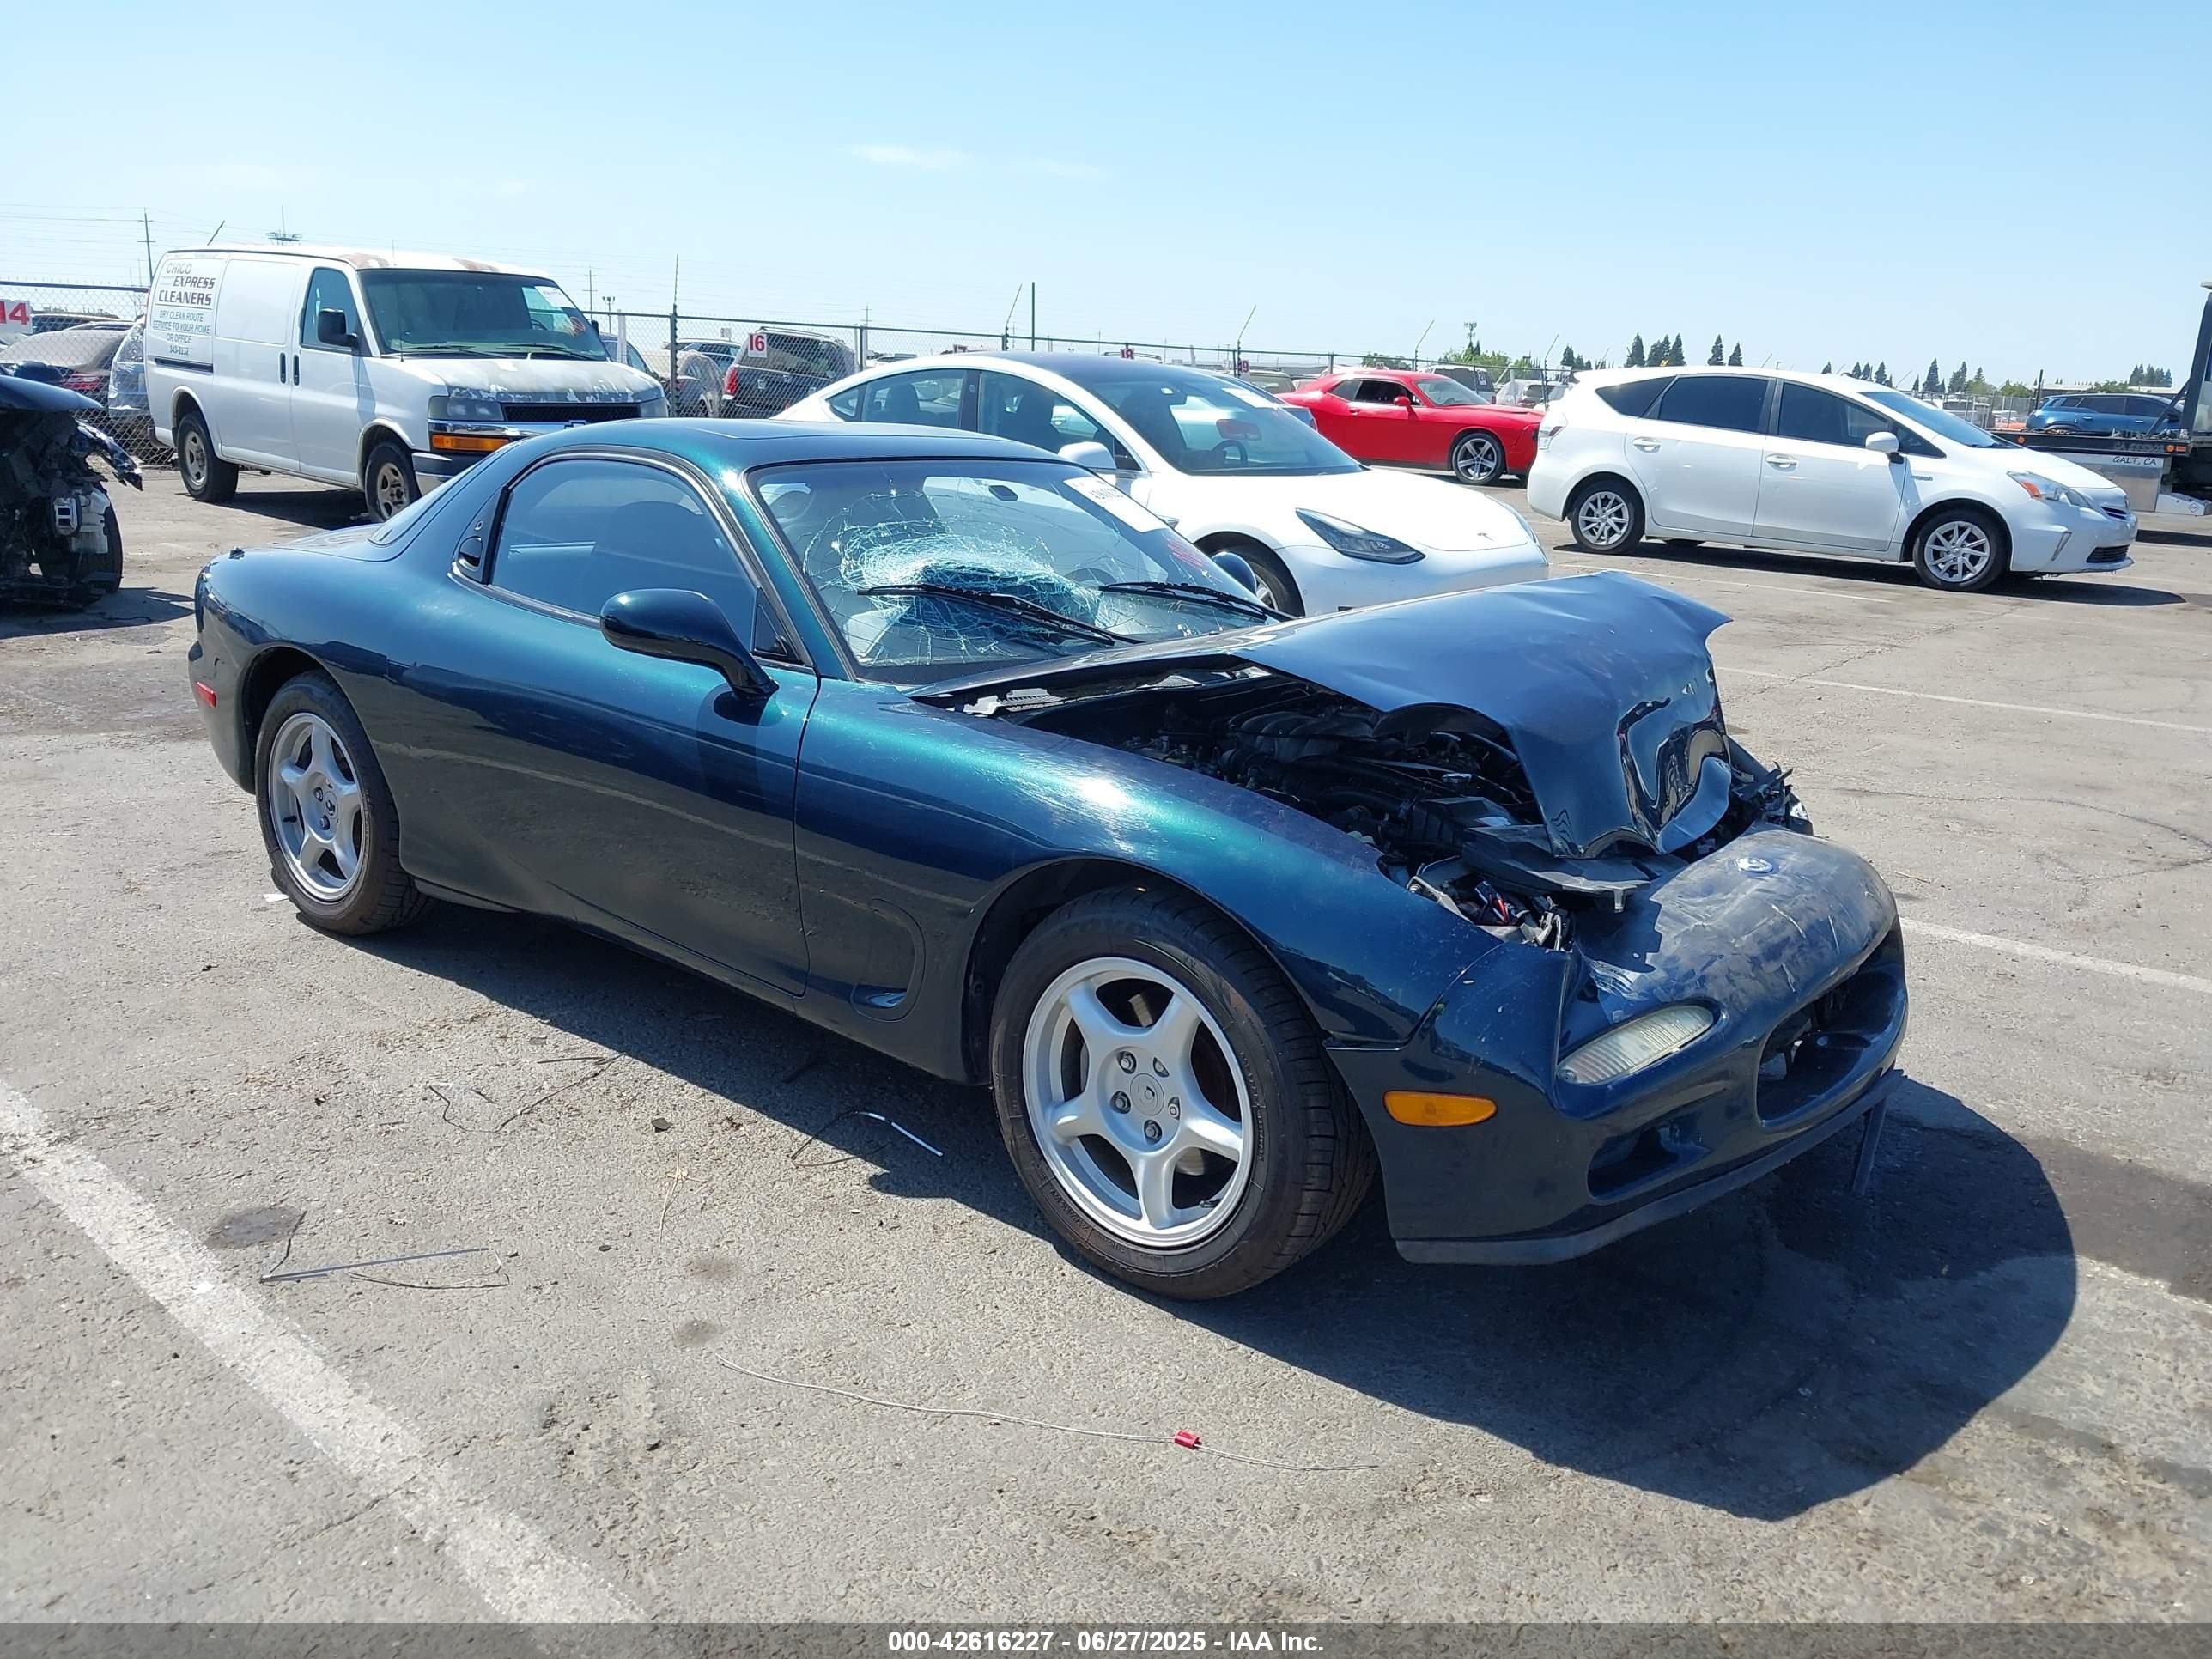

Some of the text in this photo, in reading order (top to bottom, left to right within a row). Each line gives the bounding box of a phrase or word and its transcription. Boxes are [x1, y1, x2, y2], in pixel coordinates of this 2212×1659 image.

[166, 262, 192, 275] CHICO
[173, 276, 216, 289] EXPRESS
[158, 290, 213, 306] CLEANERS
[0, 301, 30, 325] 14
[160, 310, 204, 322] DRY CLEAN ROUTE
[153, 320, 210, 334] SERVICE TO YOUR HOME
[174, 333, 192, 343] OFFICE
[749, 334, 765, 352] 16
[2112, 457, 2141, 465] GALT,
